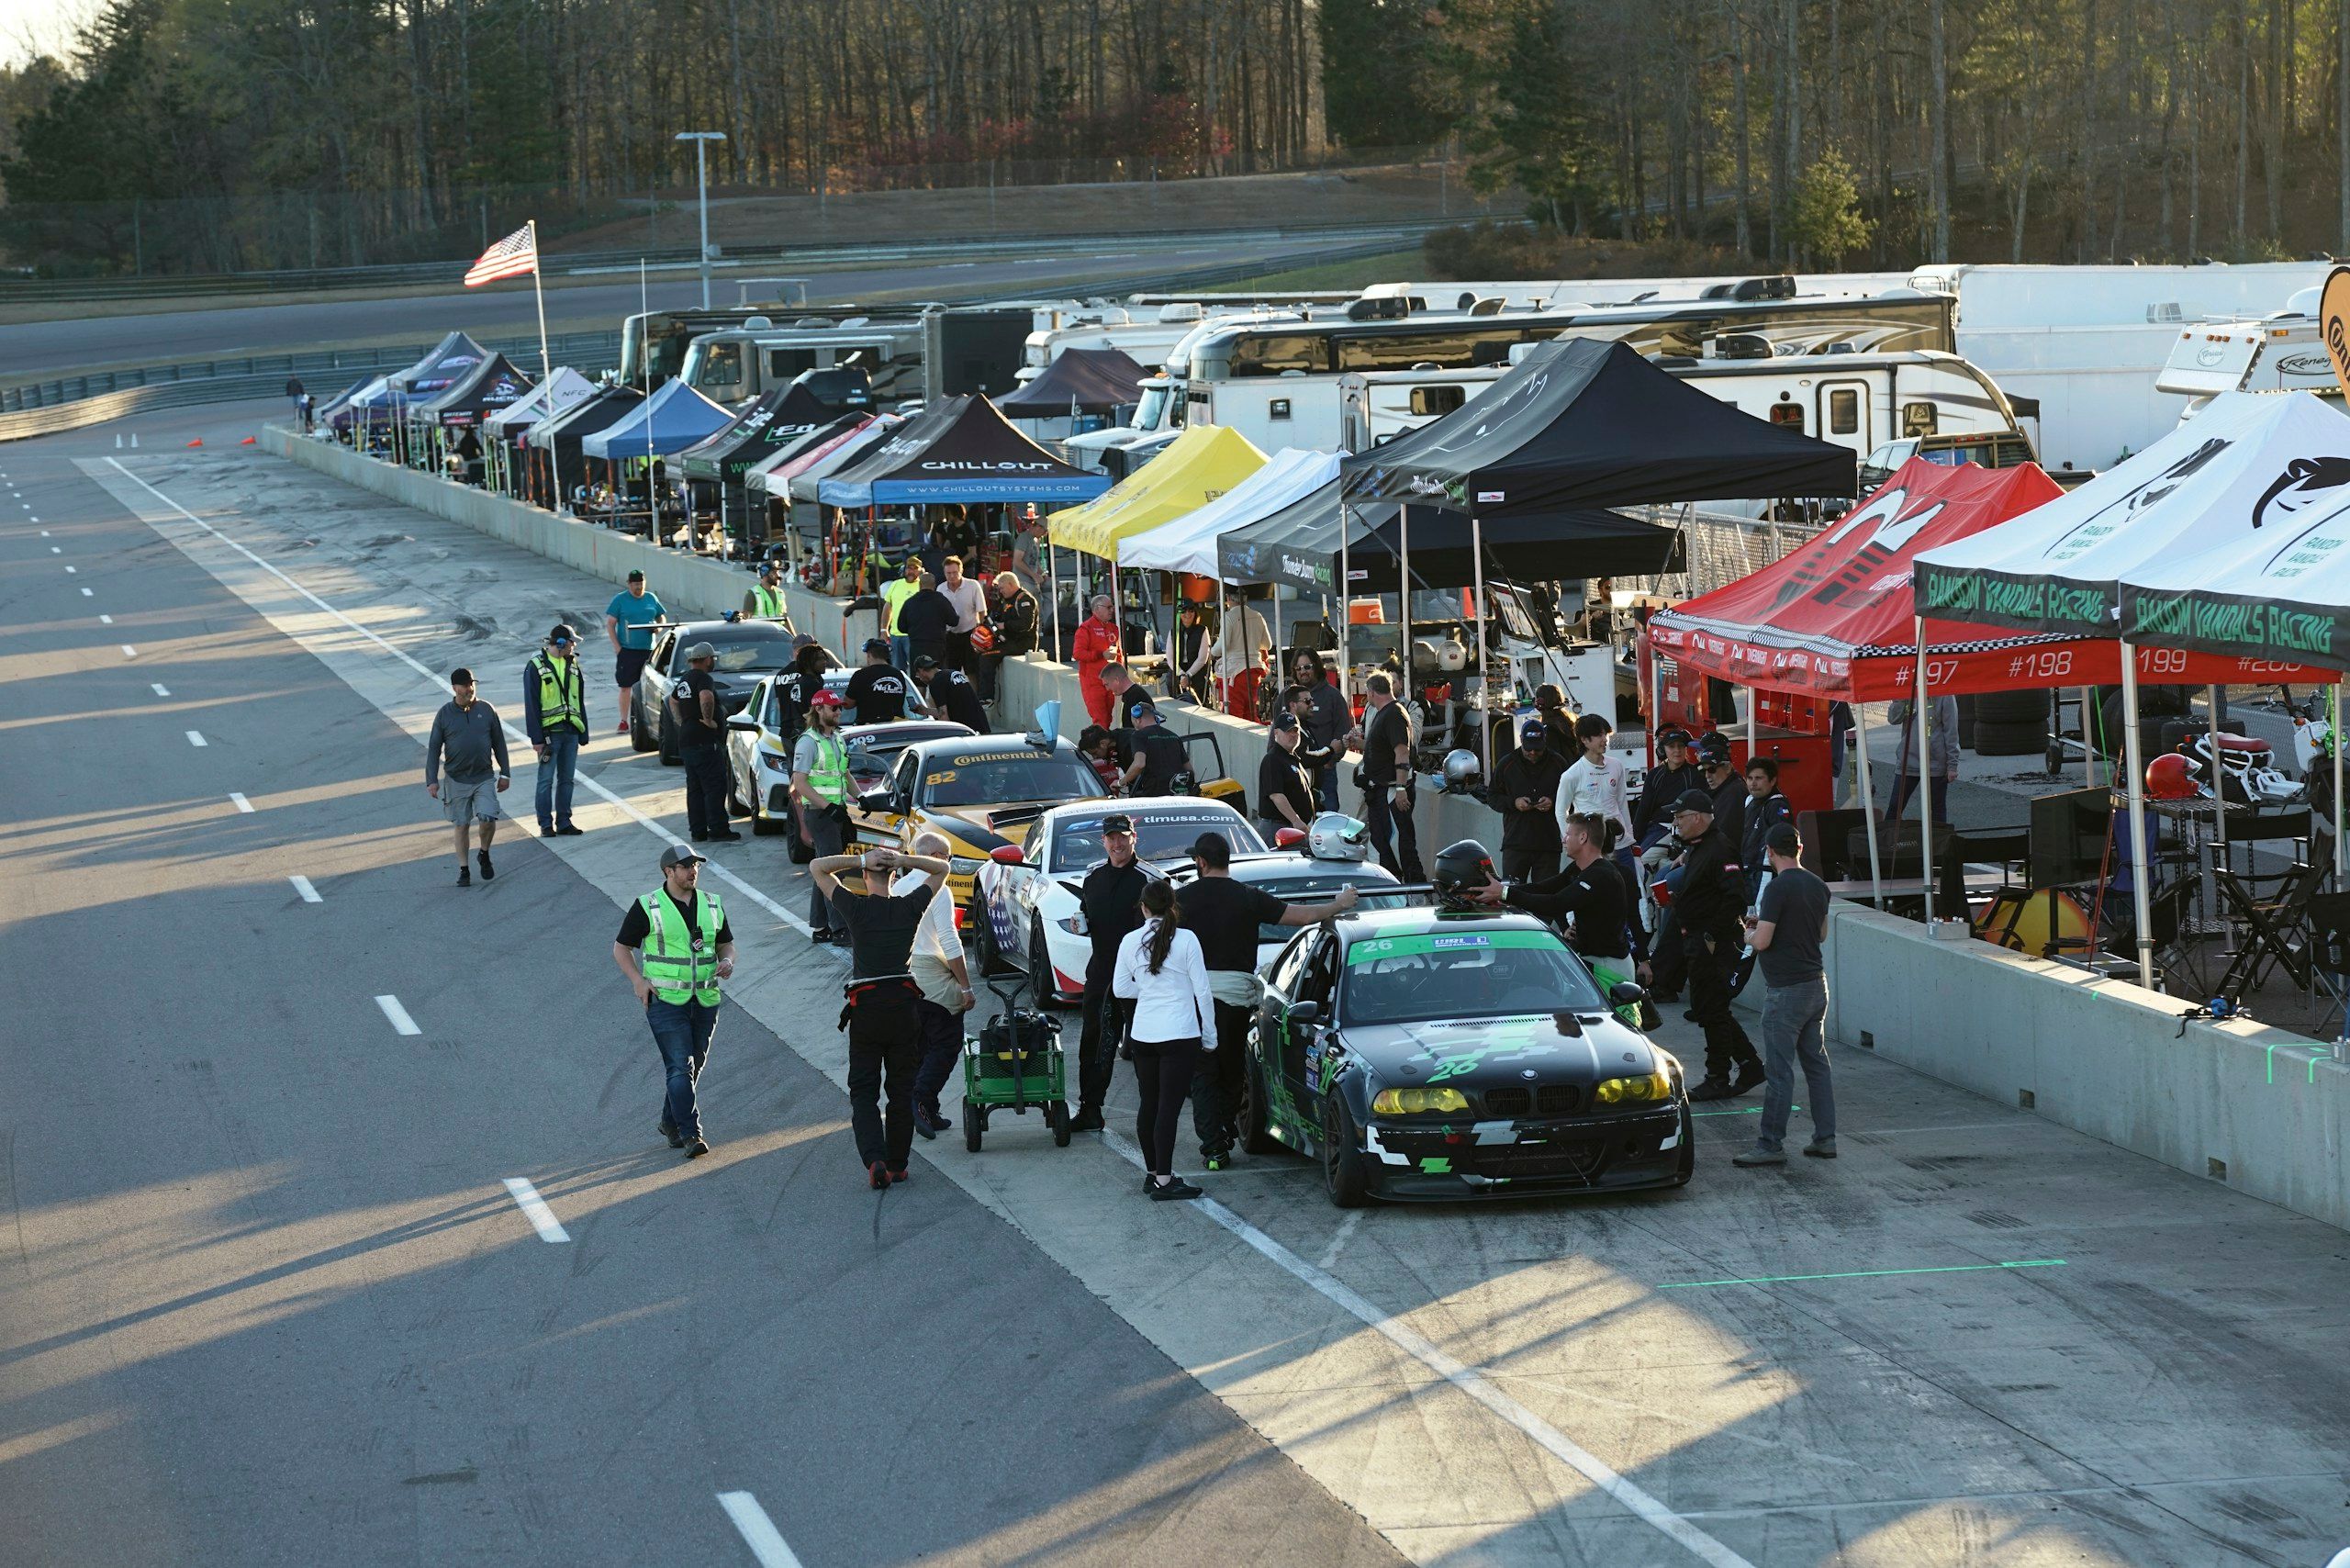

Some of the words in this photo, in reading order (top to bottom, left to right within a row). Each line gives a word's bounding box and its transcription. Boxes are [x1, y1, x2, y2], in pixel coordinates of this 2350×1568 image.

[922, 461, 1053, 471] CHILLOUT
[1927, 574, 1981, 610] RANDOM
[1984, 577, 2045, 619] VANDALS
[2048, 583, 2105, 624] RACING
[2133, 597, 2192, 636] RANDOM
[2194, 599, 2265, 644] VANDALS
[2268, 606, 2335, 654] RACING
[1896, 659, 1960, 687] #97
[2009, 651, 2073, 678] #198
[2136, 648, 2188, 674] 199
[849, 735, 876, 746] 109
[954, 751, 1039, 767] Continental
[926, 770, 957, 786] 82
[1362, 939, 1393, 953] 26
[1425, 1058, 1479, 1083] 26
